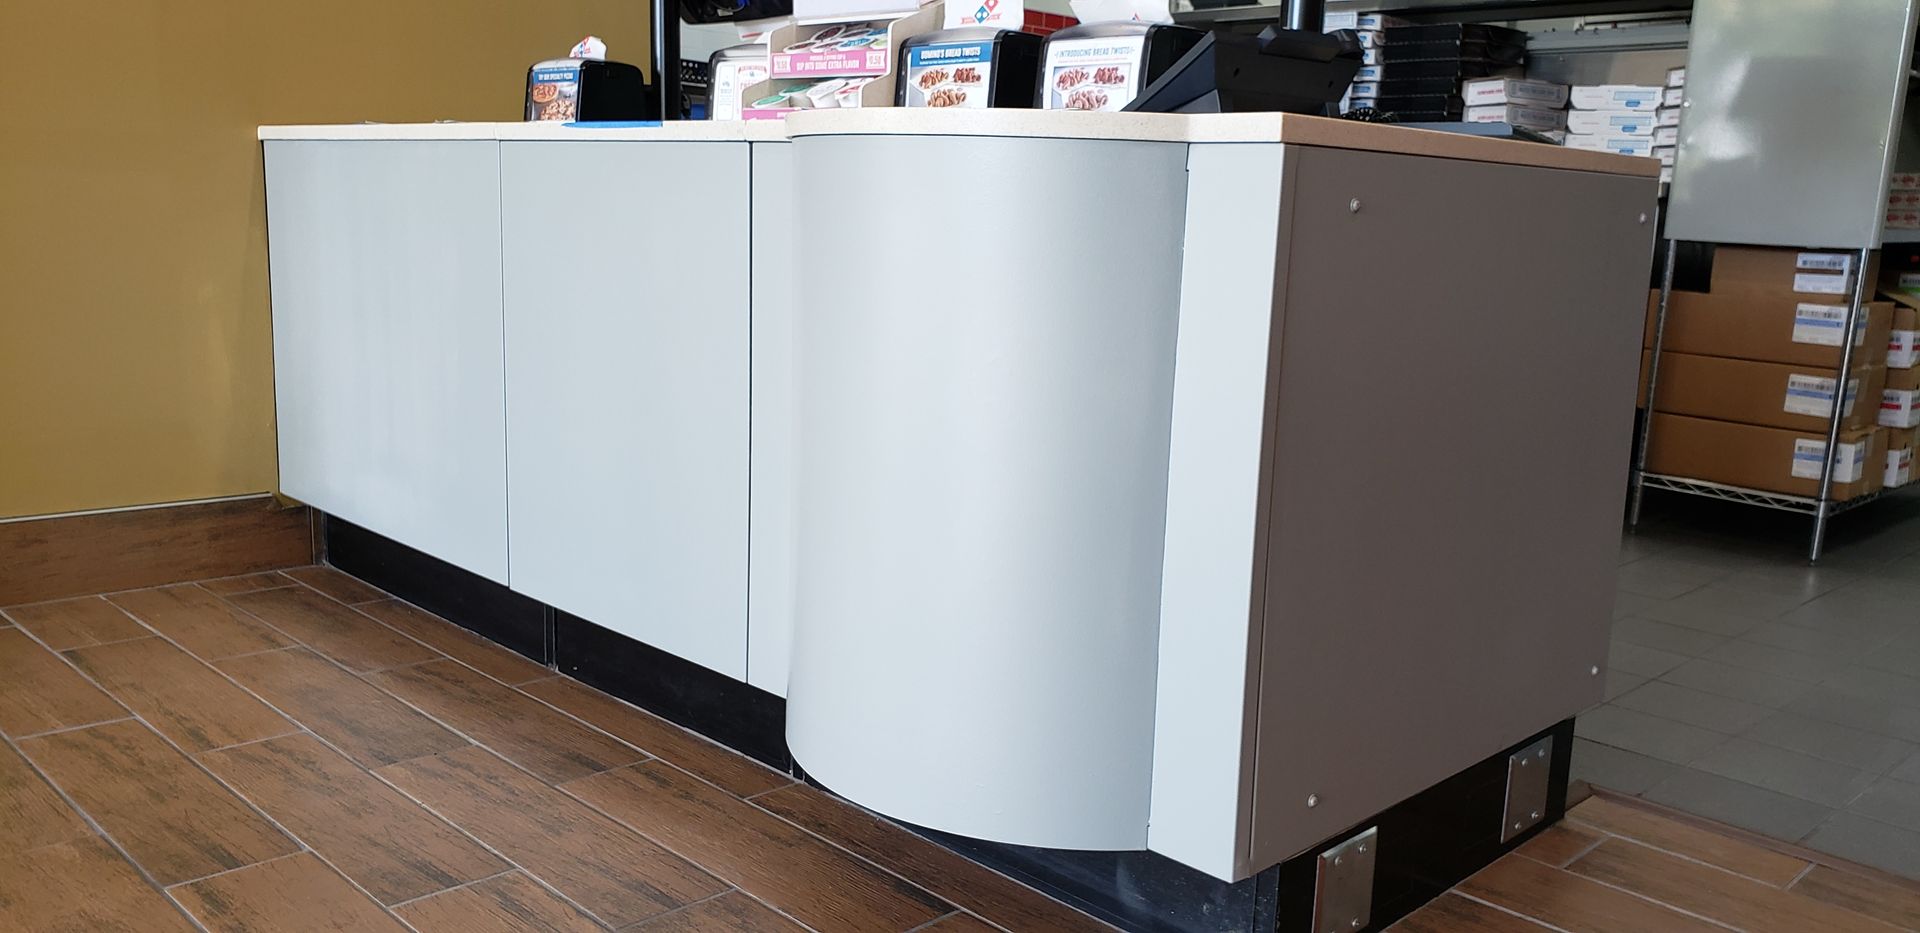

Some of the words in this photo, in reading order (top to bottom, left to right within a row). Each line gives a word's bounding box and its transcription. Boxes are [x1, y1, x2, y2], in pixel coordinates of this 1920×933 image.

[962, 46, 981, 56] TWISTS
[1059, 48, 1092, 58] INTRODUCING
[1092, 47, 1110, 56] BREAD
[1110, 46, 1131, 55] TWISTS
[828, 60, 842, 70] EXTRA
[842, 59, 860, 70] FLAVOR
